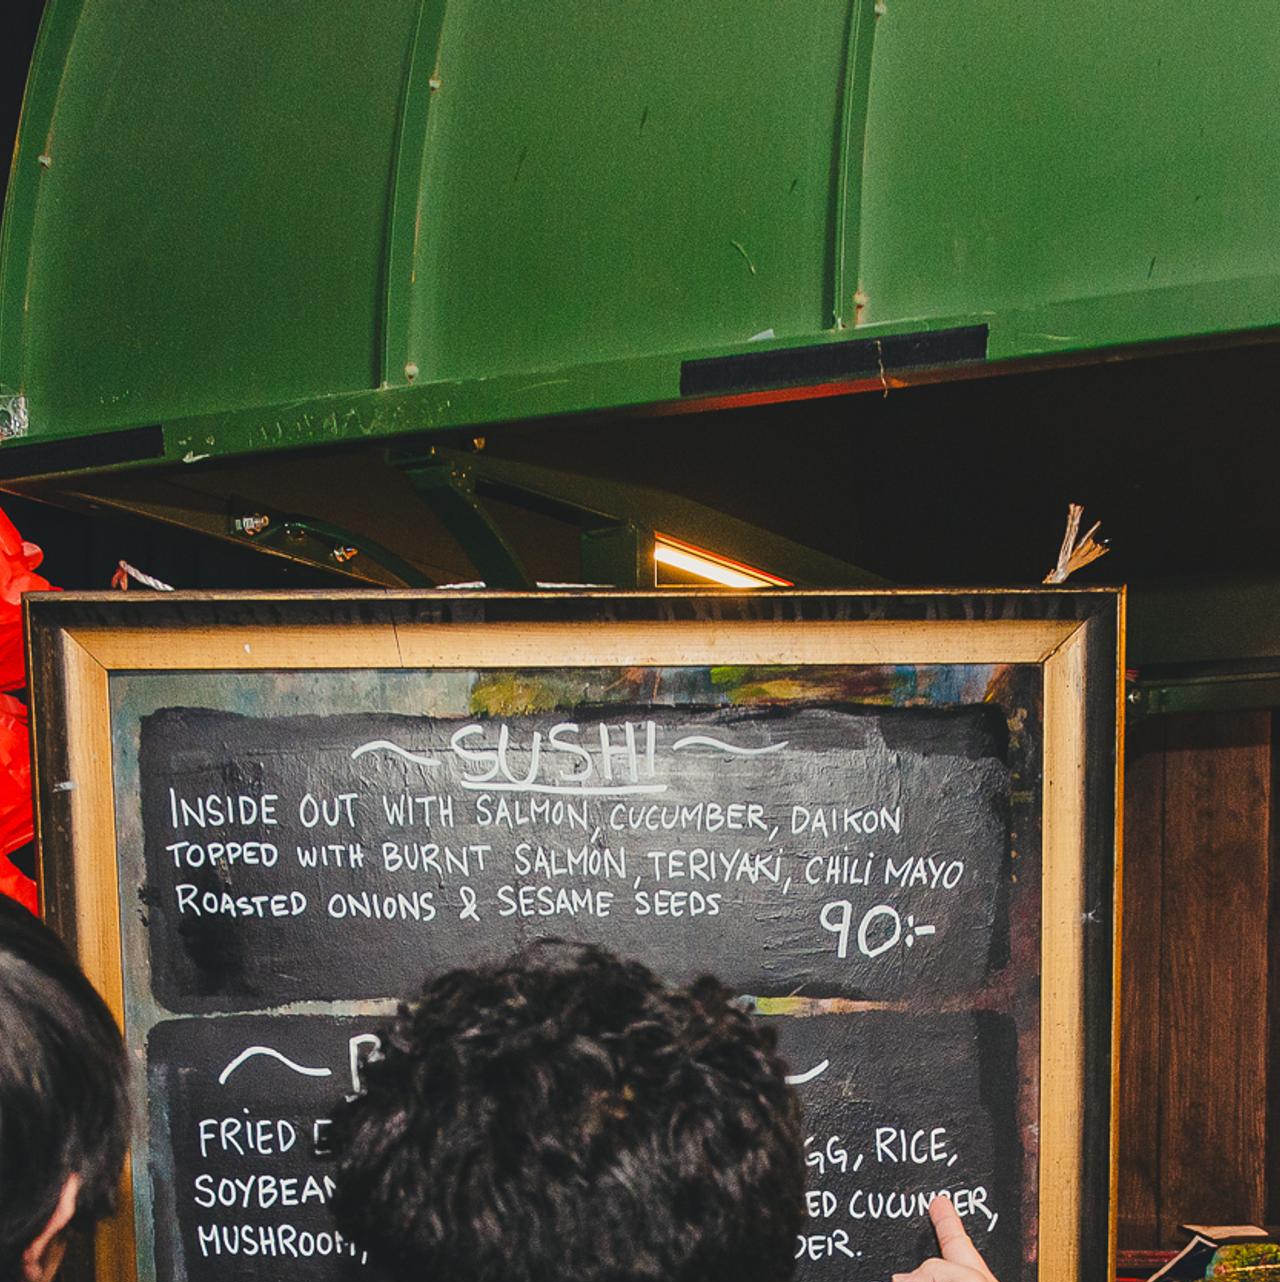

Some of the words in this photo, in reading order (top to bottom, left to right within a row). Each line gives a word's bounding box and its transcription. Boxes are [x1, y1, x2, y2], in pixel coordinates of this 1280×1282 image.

[451, 720, 656, 785] SUSHI
[169, 787, 279, 829] INSIDE
[299, 793, 359, 828] OUT
[383, 794, 454, 828] WITH
[476, 794, 600, 843] SALMON,
[610, 801, 779, 842] CUCUMBER,
[791, 805, 902, 838] DAIKON
[166, 841, 279, 868] TOPPED
[297, 845, 365, 868] WITH
[382, 841, 492, 877] BURNT
[515, 844, 641, 889] SALMON,
[885, 856, 965, 889] MAYO
[176, 884, 307, 918] ROASTED
[327, 891, 437, 922] ONIONS
[459, 886, 480, 922] &
[497, 885, 614, 917] SESAME
[635, 890, 722, 916] SEEDS
[820, 900, 936, 958] 90:-
[198, 1107, 296, 1158] FRIED
[804, 1135, 864, 1174] GG,
[876, 1127, 958, 1167] RICE,
